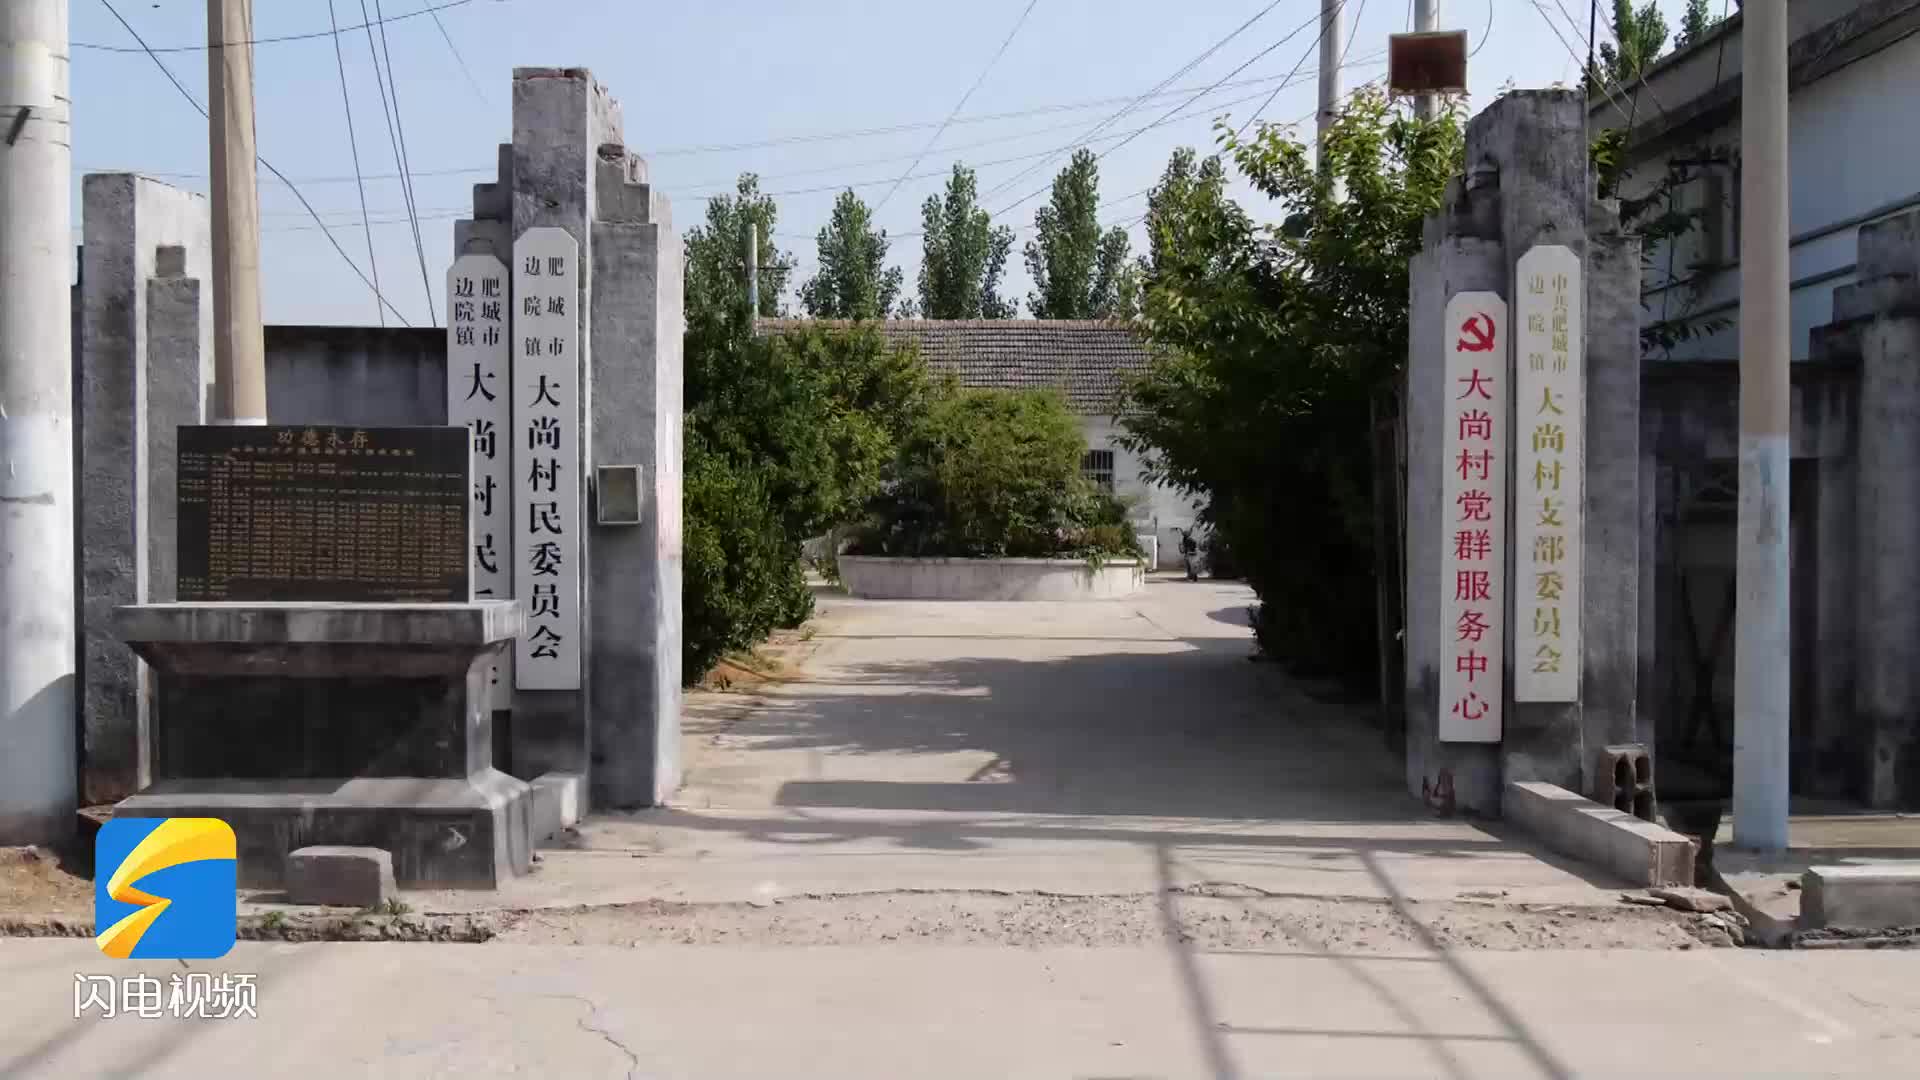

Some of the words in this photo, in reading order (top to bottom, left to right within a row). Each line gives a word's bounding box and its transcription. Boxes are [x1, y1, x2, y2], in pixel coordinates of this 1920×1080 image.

[454, 277, 475, 346] 边院镇
[480, 277, 501, 346] 肥城市
[523, 256, 541, 356] 边院镇
[547, 256, 565, 356] 肥城市
[1528, 275, 1545, 373] 边院镇
[1552, 274, 1568, 374] 中共肥城市
[277, 428, 368, 449] 功德永存
[528, 375, 563, 659] 大尚村民委员会
[1452, 368, 1495, 720] 大尚村党群服务中心
[1532, 386, 1566, 674] 大尚村支部委员会
